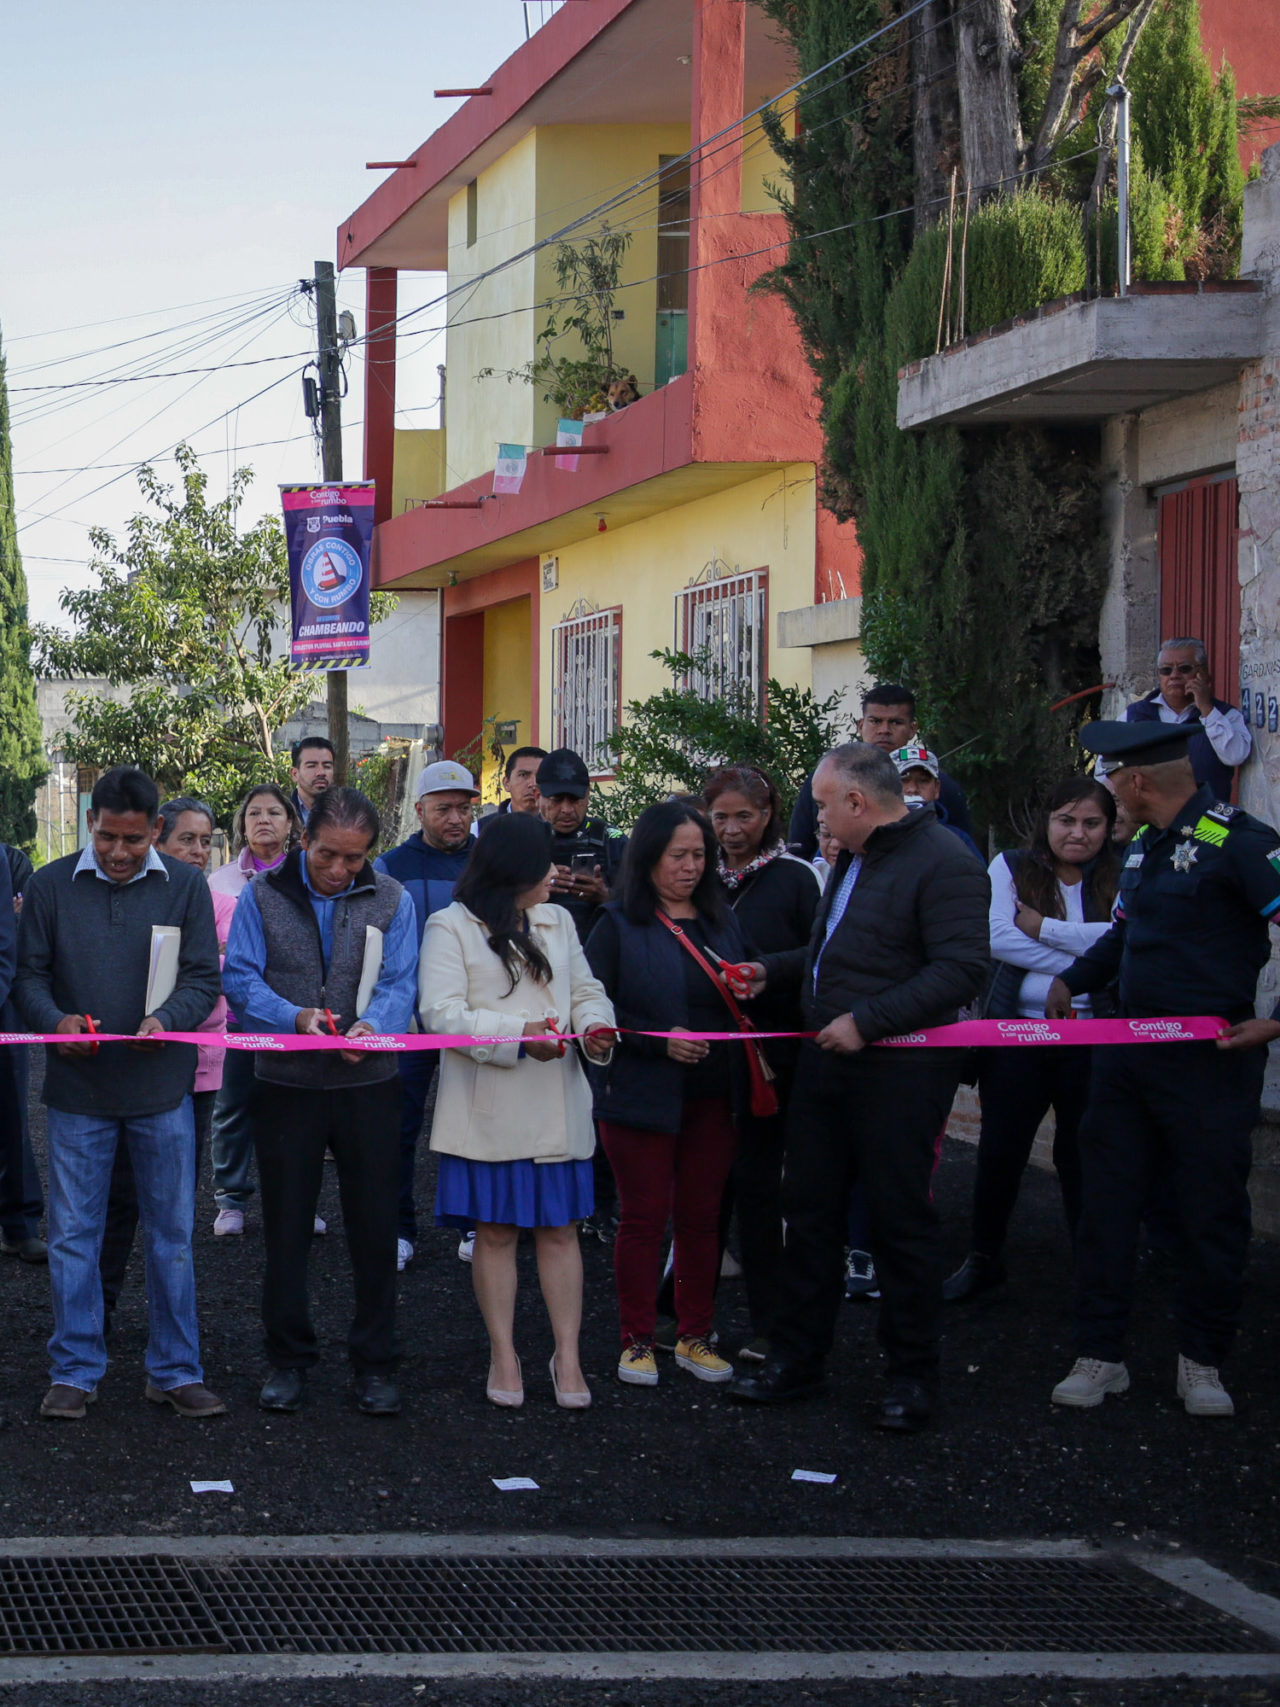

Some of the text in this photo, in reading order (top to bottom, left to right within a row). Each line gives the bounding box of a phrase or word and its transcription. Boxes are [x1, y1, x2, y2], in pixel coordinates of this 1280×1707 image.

[322, 514, 353, 524] Puebla
[298, 620, 365, 637] CHAMBEANDO
[997, 1021, 1049, 1033] Contigo
[1129, 1020, 1182, 1032] Contigo
[224, 1034, 274, 1043] Contigo
[882, 1033, 926, 1044] rumbo
[1017, 1031, 1061, 1042] rumbo
[1150, 1031, 1193, 1039] rumbo
